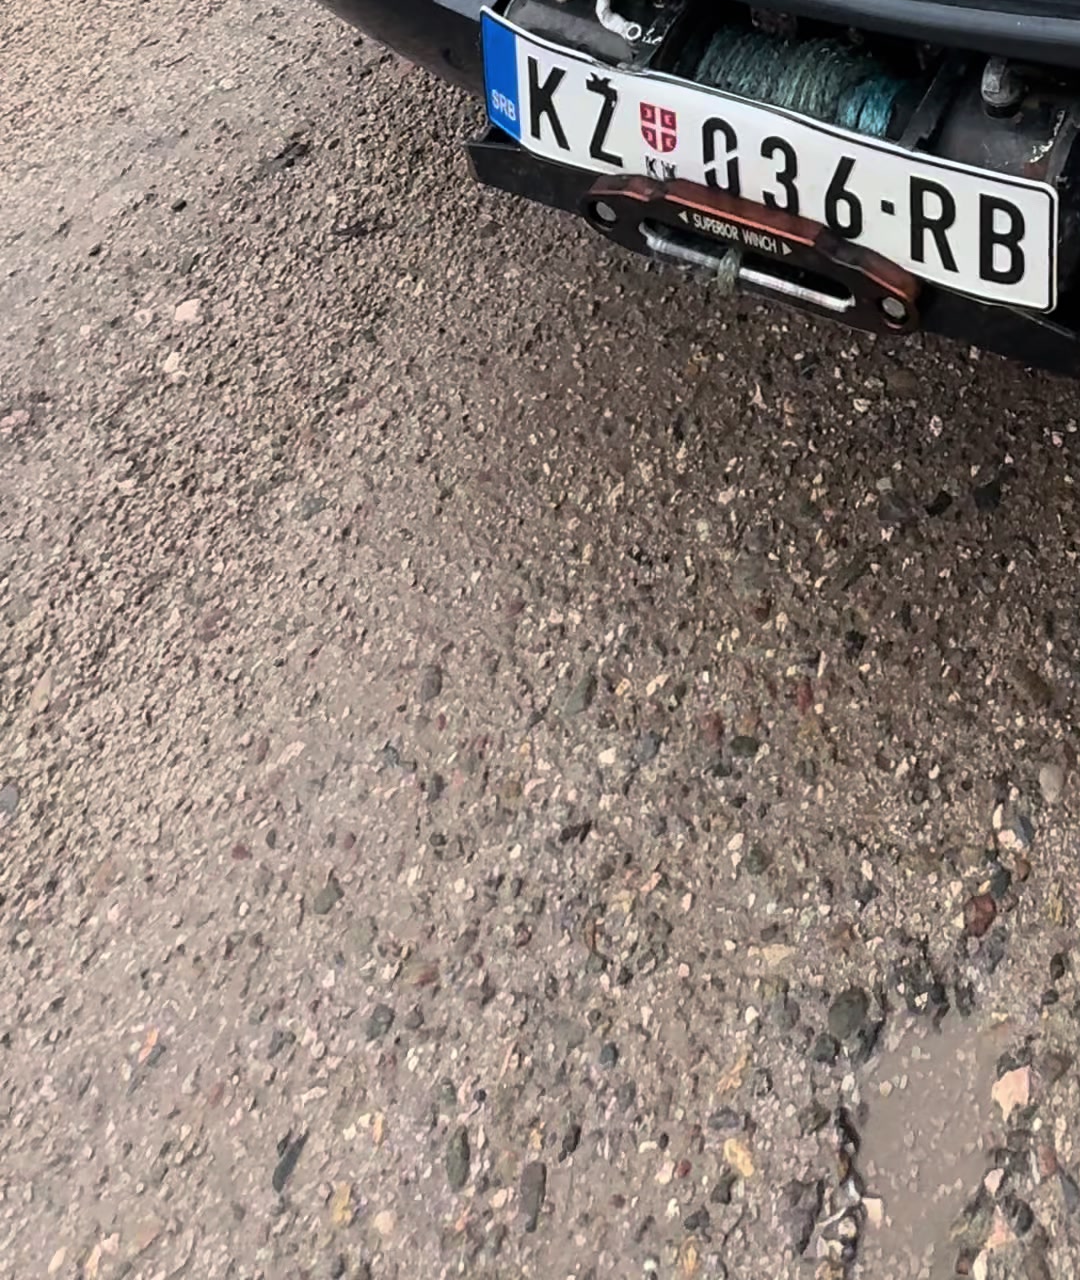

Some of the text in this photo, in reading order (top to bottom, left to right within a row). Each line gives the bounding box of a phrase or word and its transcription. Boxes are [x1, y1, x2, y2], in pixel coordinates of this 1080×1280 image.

[491, 89, 516, 121] SRB
[527, 55, 624, 168] KŽ
[692, 212, 778, 254] SUPERIOR WINCH
